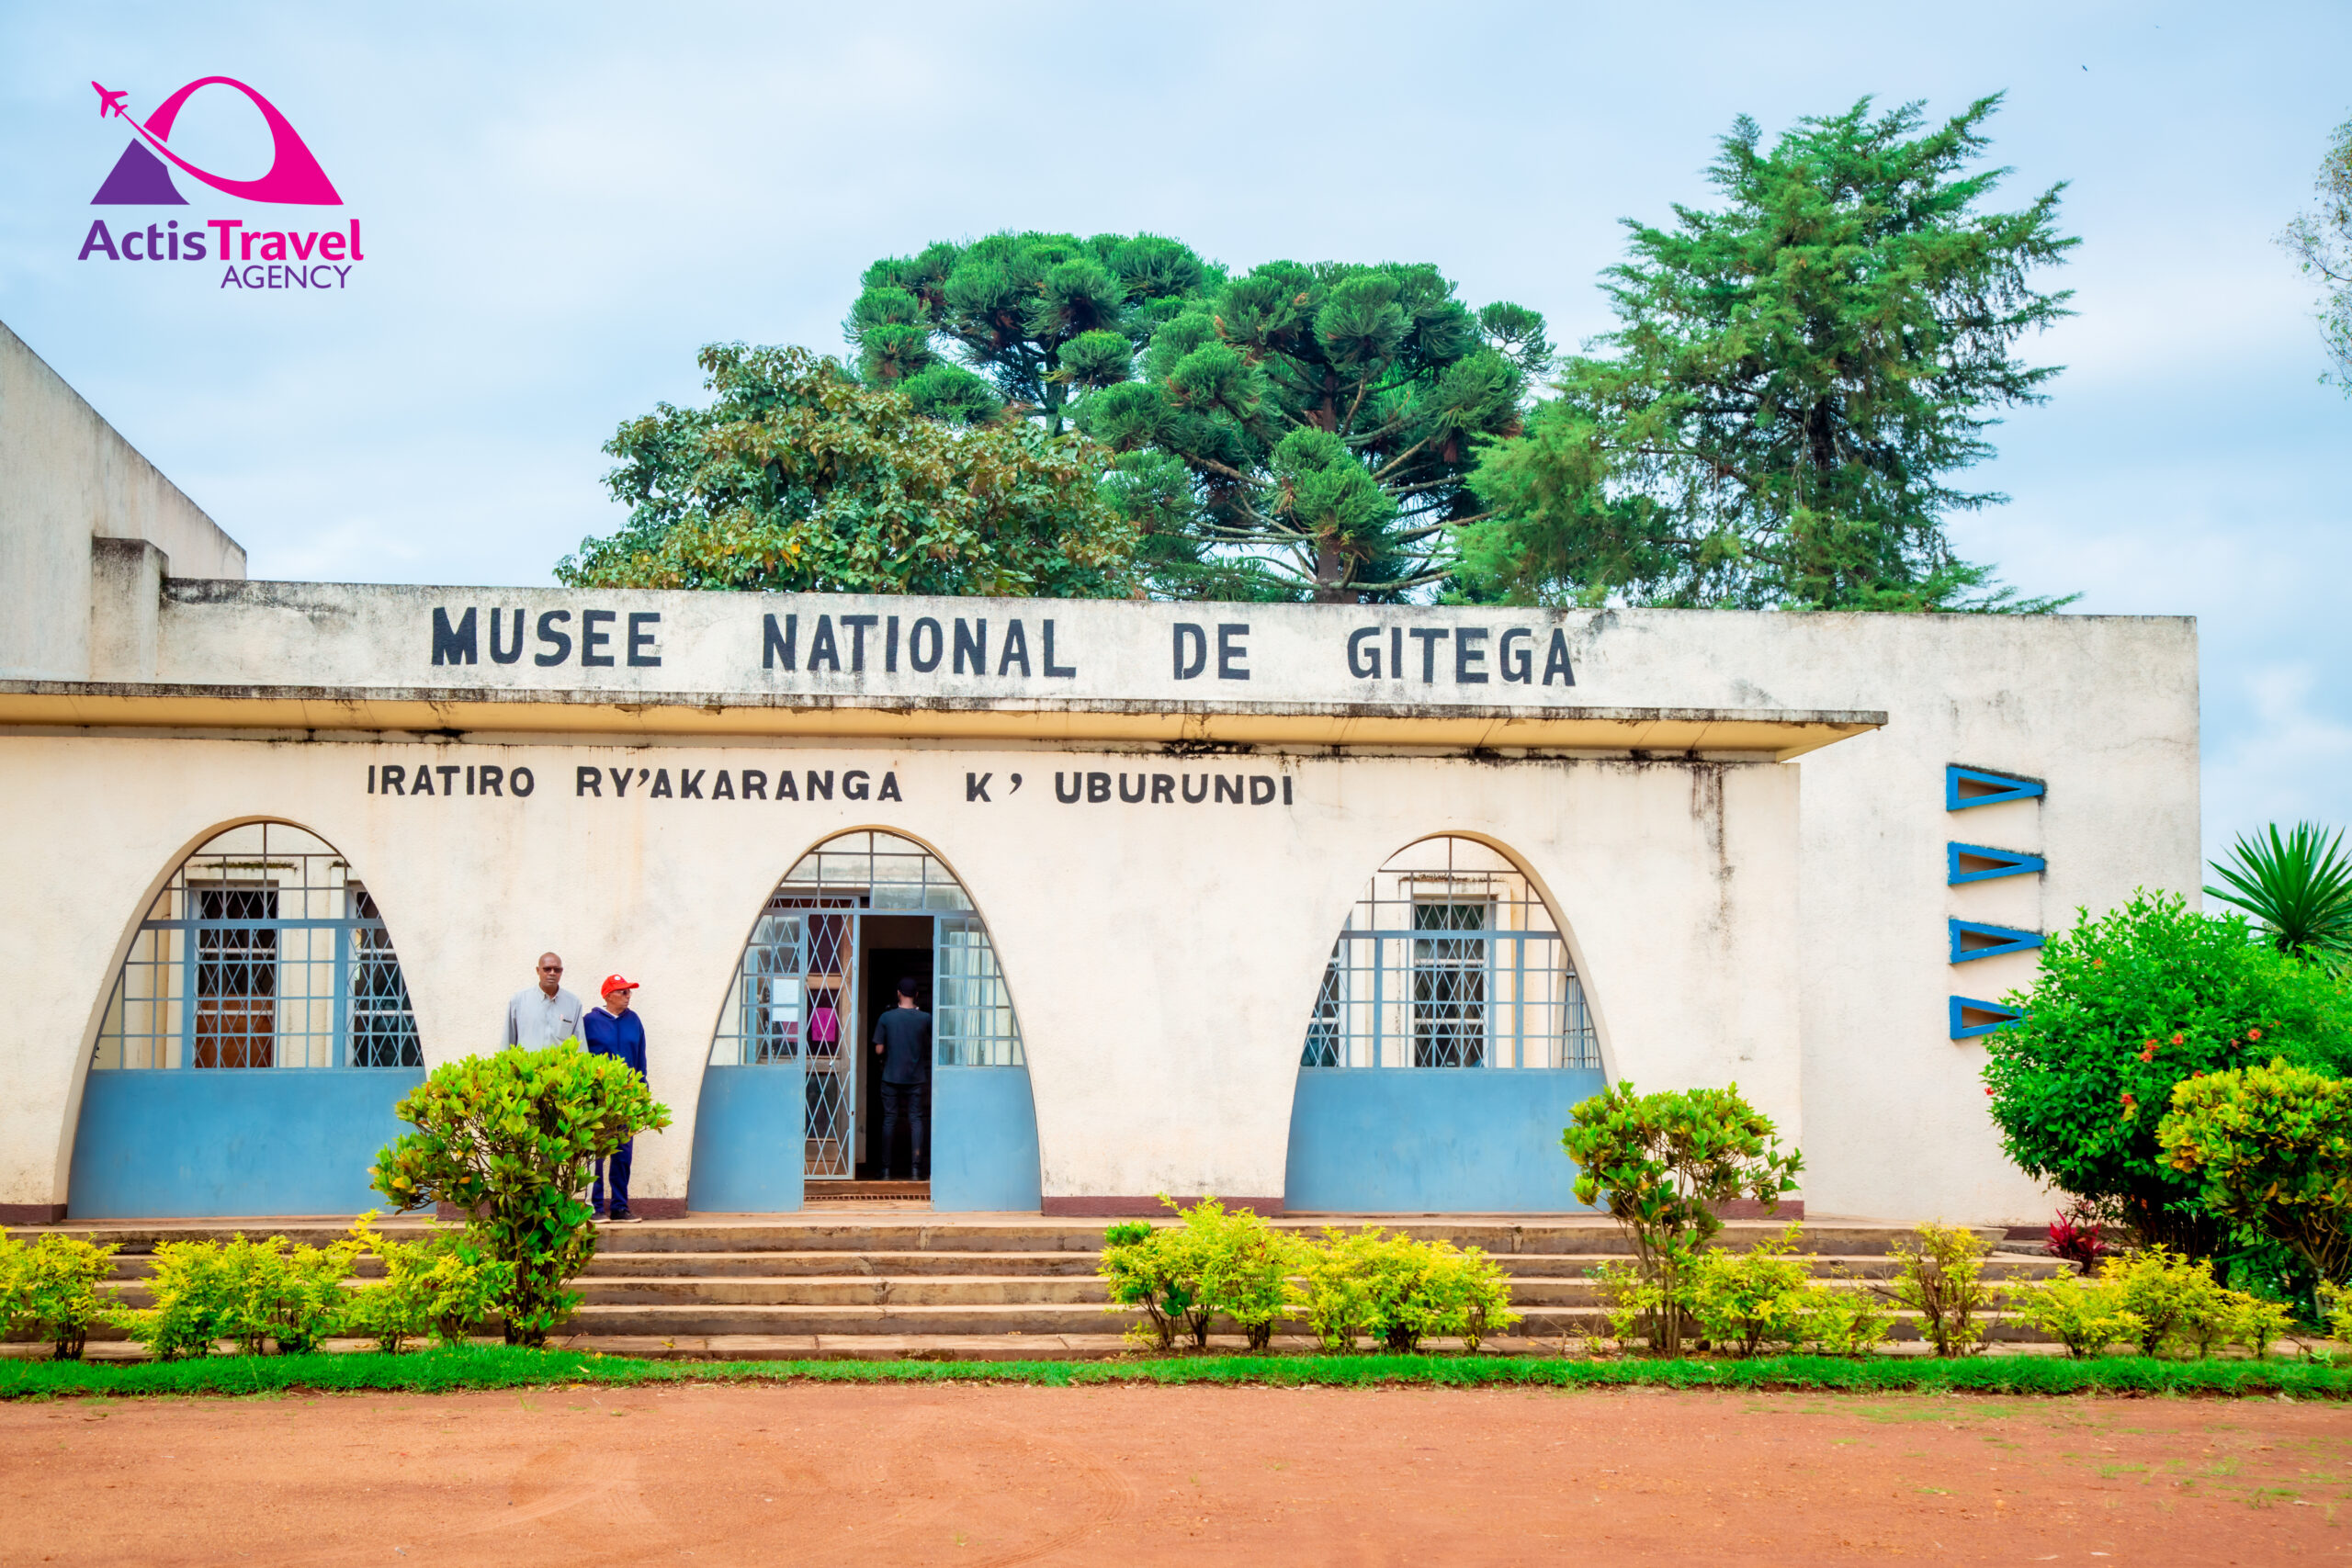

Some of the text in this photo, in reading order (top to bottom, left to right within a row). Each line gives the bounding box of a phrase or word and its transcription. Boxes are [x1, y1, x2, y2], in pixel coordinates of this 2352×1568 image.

[431, 606, 1577, 687] MUSEE NATIONAL DE GITEGA
[368, 765, 535, 797] IRATIRO
[576, 766, 903, 802] RY’AKARANGA
[1055, 772, 1293, 806] UBURUNDI
